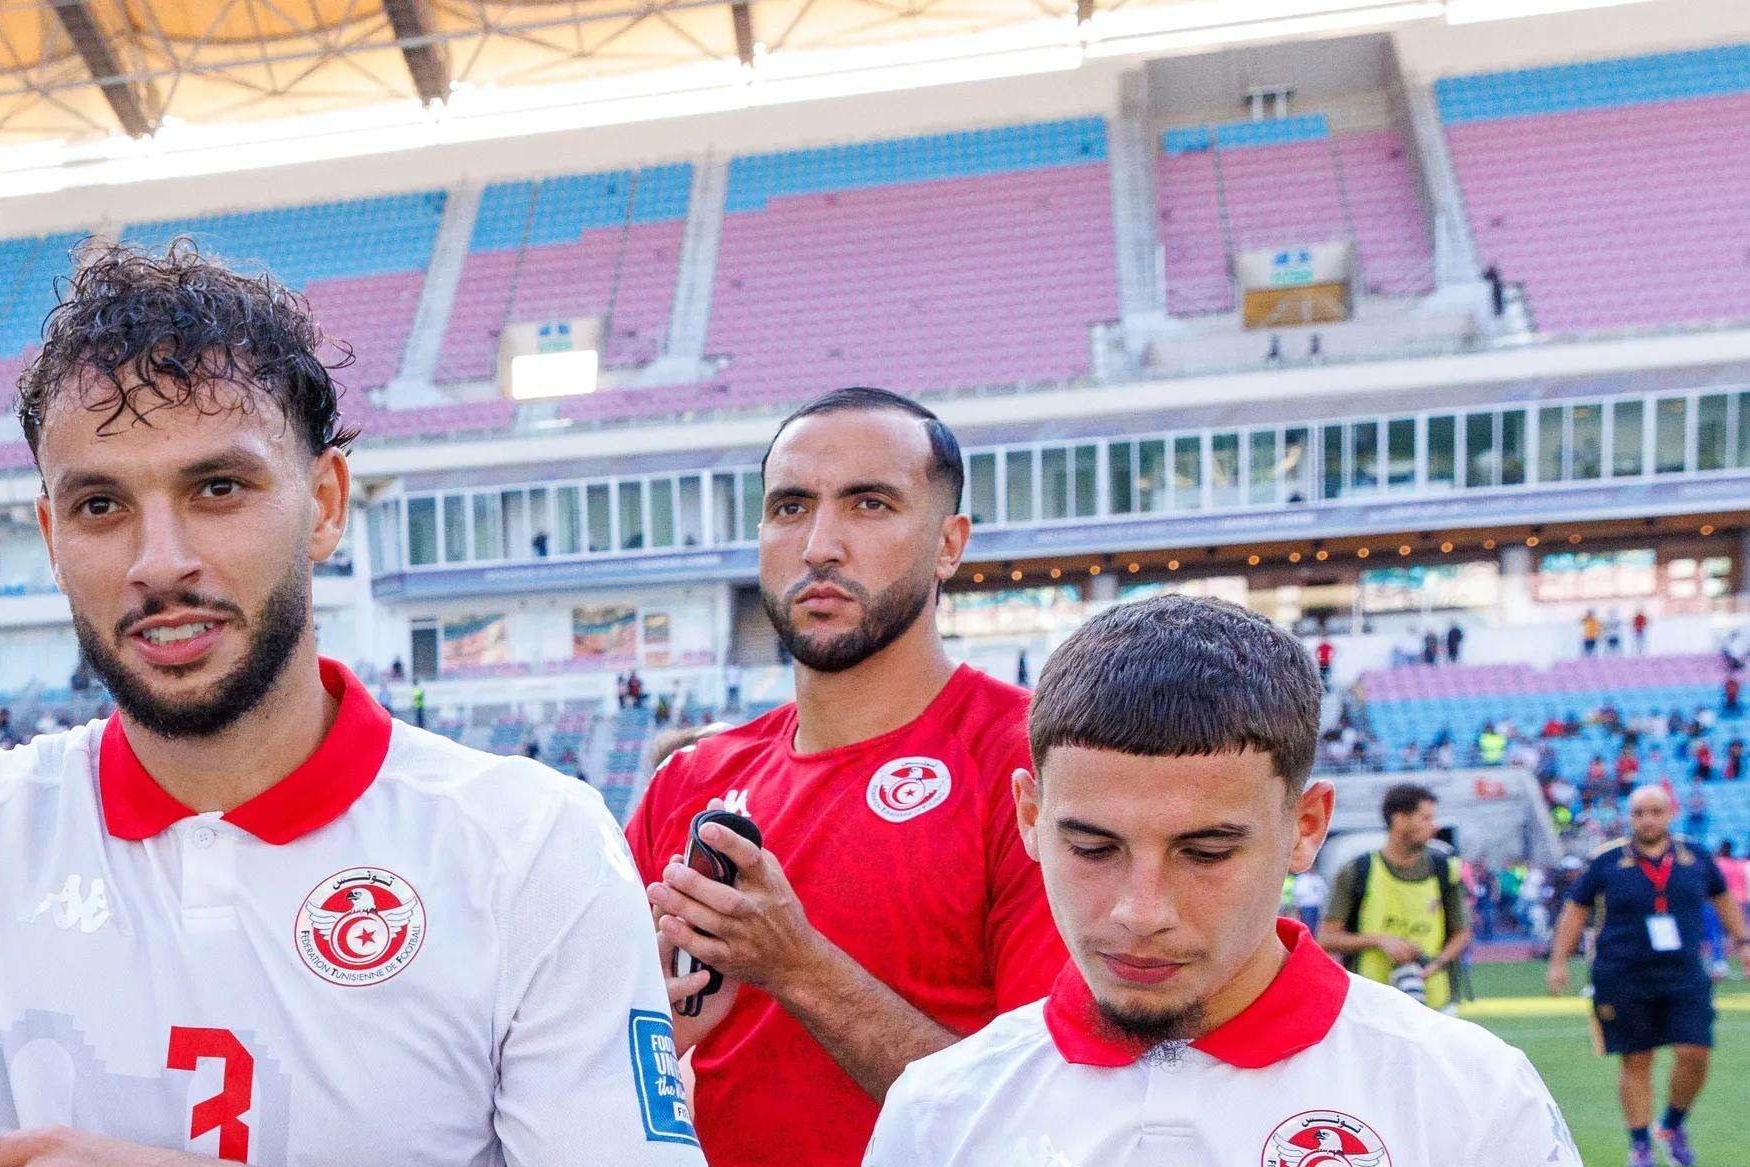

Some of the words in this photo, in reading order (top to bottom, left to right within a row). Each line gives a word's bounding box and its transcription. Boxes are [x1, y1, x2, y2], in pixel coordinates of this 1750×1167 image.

[332, 870, 395, 890] تونس
[301, 930, 330, 973] FEDERATION
[330, 968, 384, 982] TUNISIENNE
[387, 963, 398, 973] DE
[395, 926, 421, 964] FOOTBALL
[166, 1025, 255, 1165] 3
[1301, 1115, 1364, 1134] تونس
